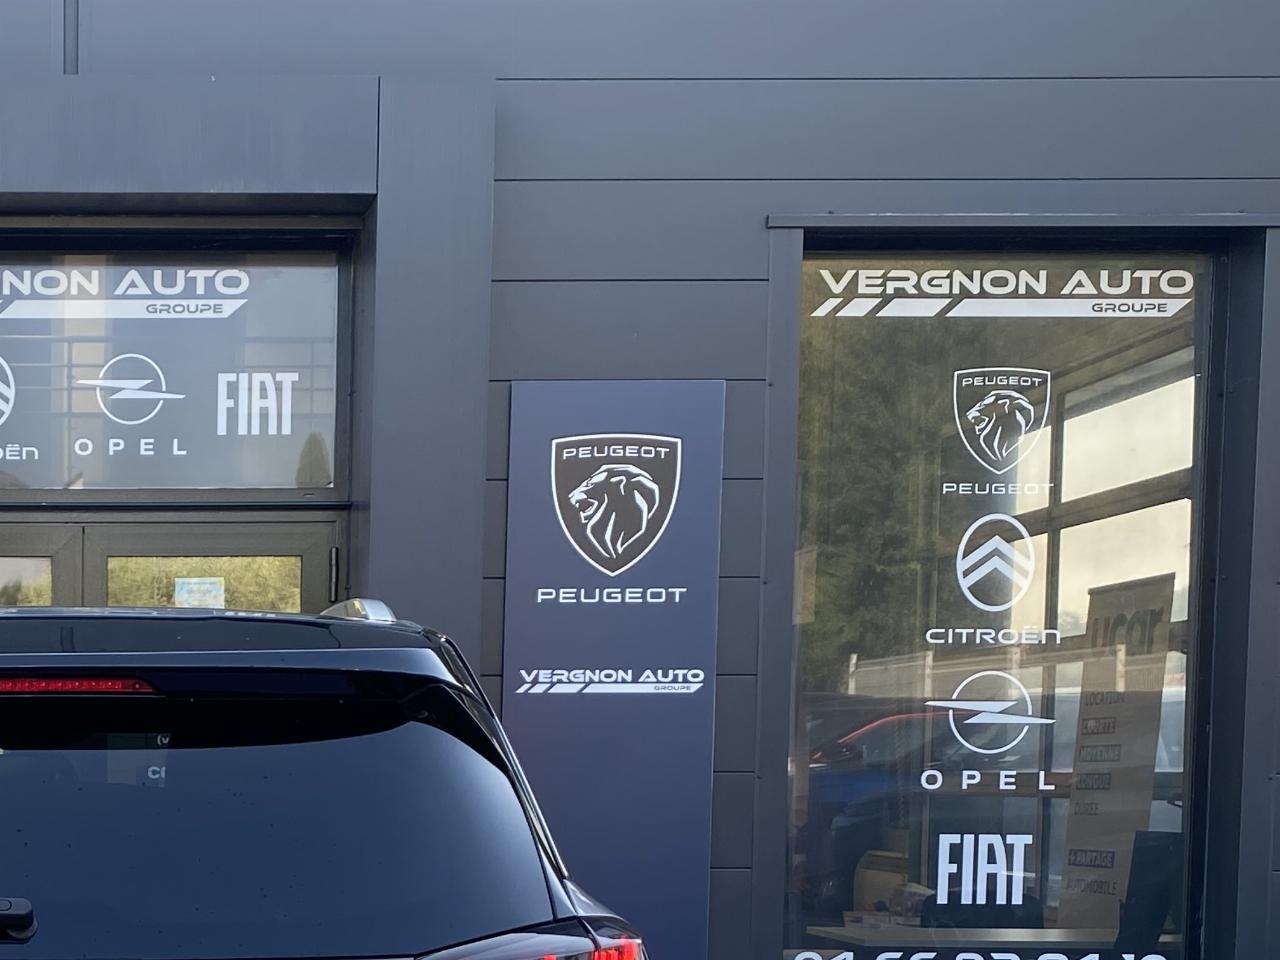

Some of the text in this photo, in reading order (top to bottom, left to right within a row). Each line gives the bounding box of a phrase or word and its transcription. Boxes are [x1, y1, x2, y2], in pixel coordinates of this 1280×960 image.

[113, 269, 250, 296] AUTO
[819, 269, 1194, 295] VERGNON AUTO
[145, 303, 224, 315] GROUPE
[1091, 303, 1168, 313] GROUPE
[961, 376, 1043, 388] PEUGEOT
[217, 372, 299, 436] FIAT
[74, 438, 187, 457] OPEL
[562, 445, 670, 460] PEUGEOT
[942, 482, 1054, 495] PEUGEOT
[537, 587, 688, 604] PEUGEOT
[520, 669, 705, 683] VERGNON AUTO
[653, 684, 692, 692] GROUPE
[920, 769, 1056, 791] OPEL
[936, 833, 1033, 905] FIAT
